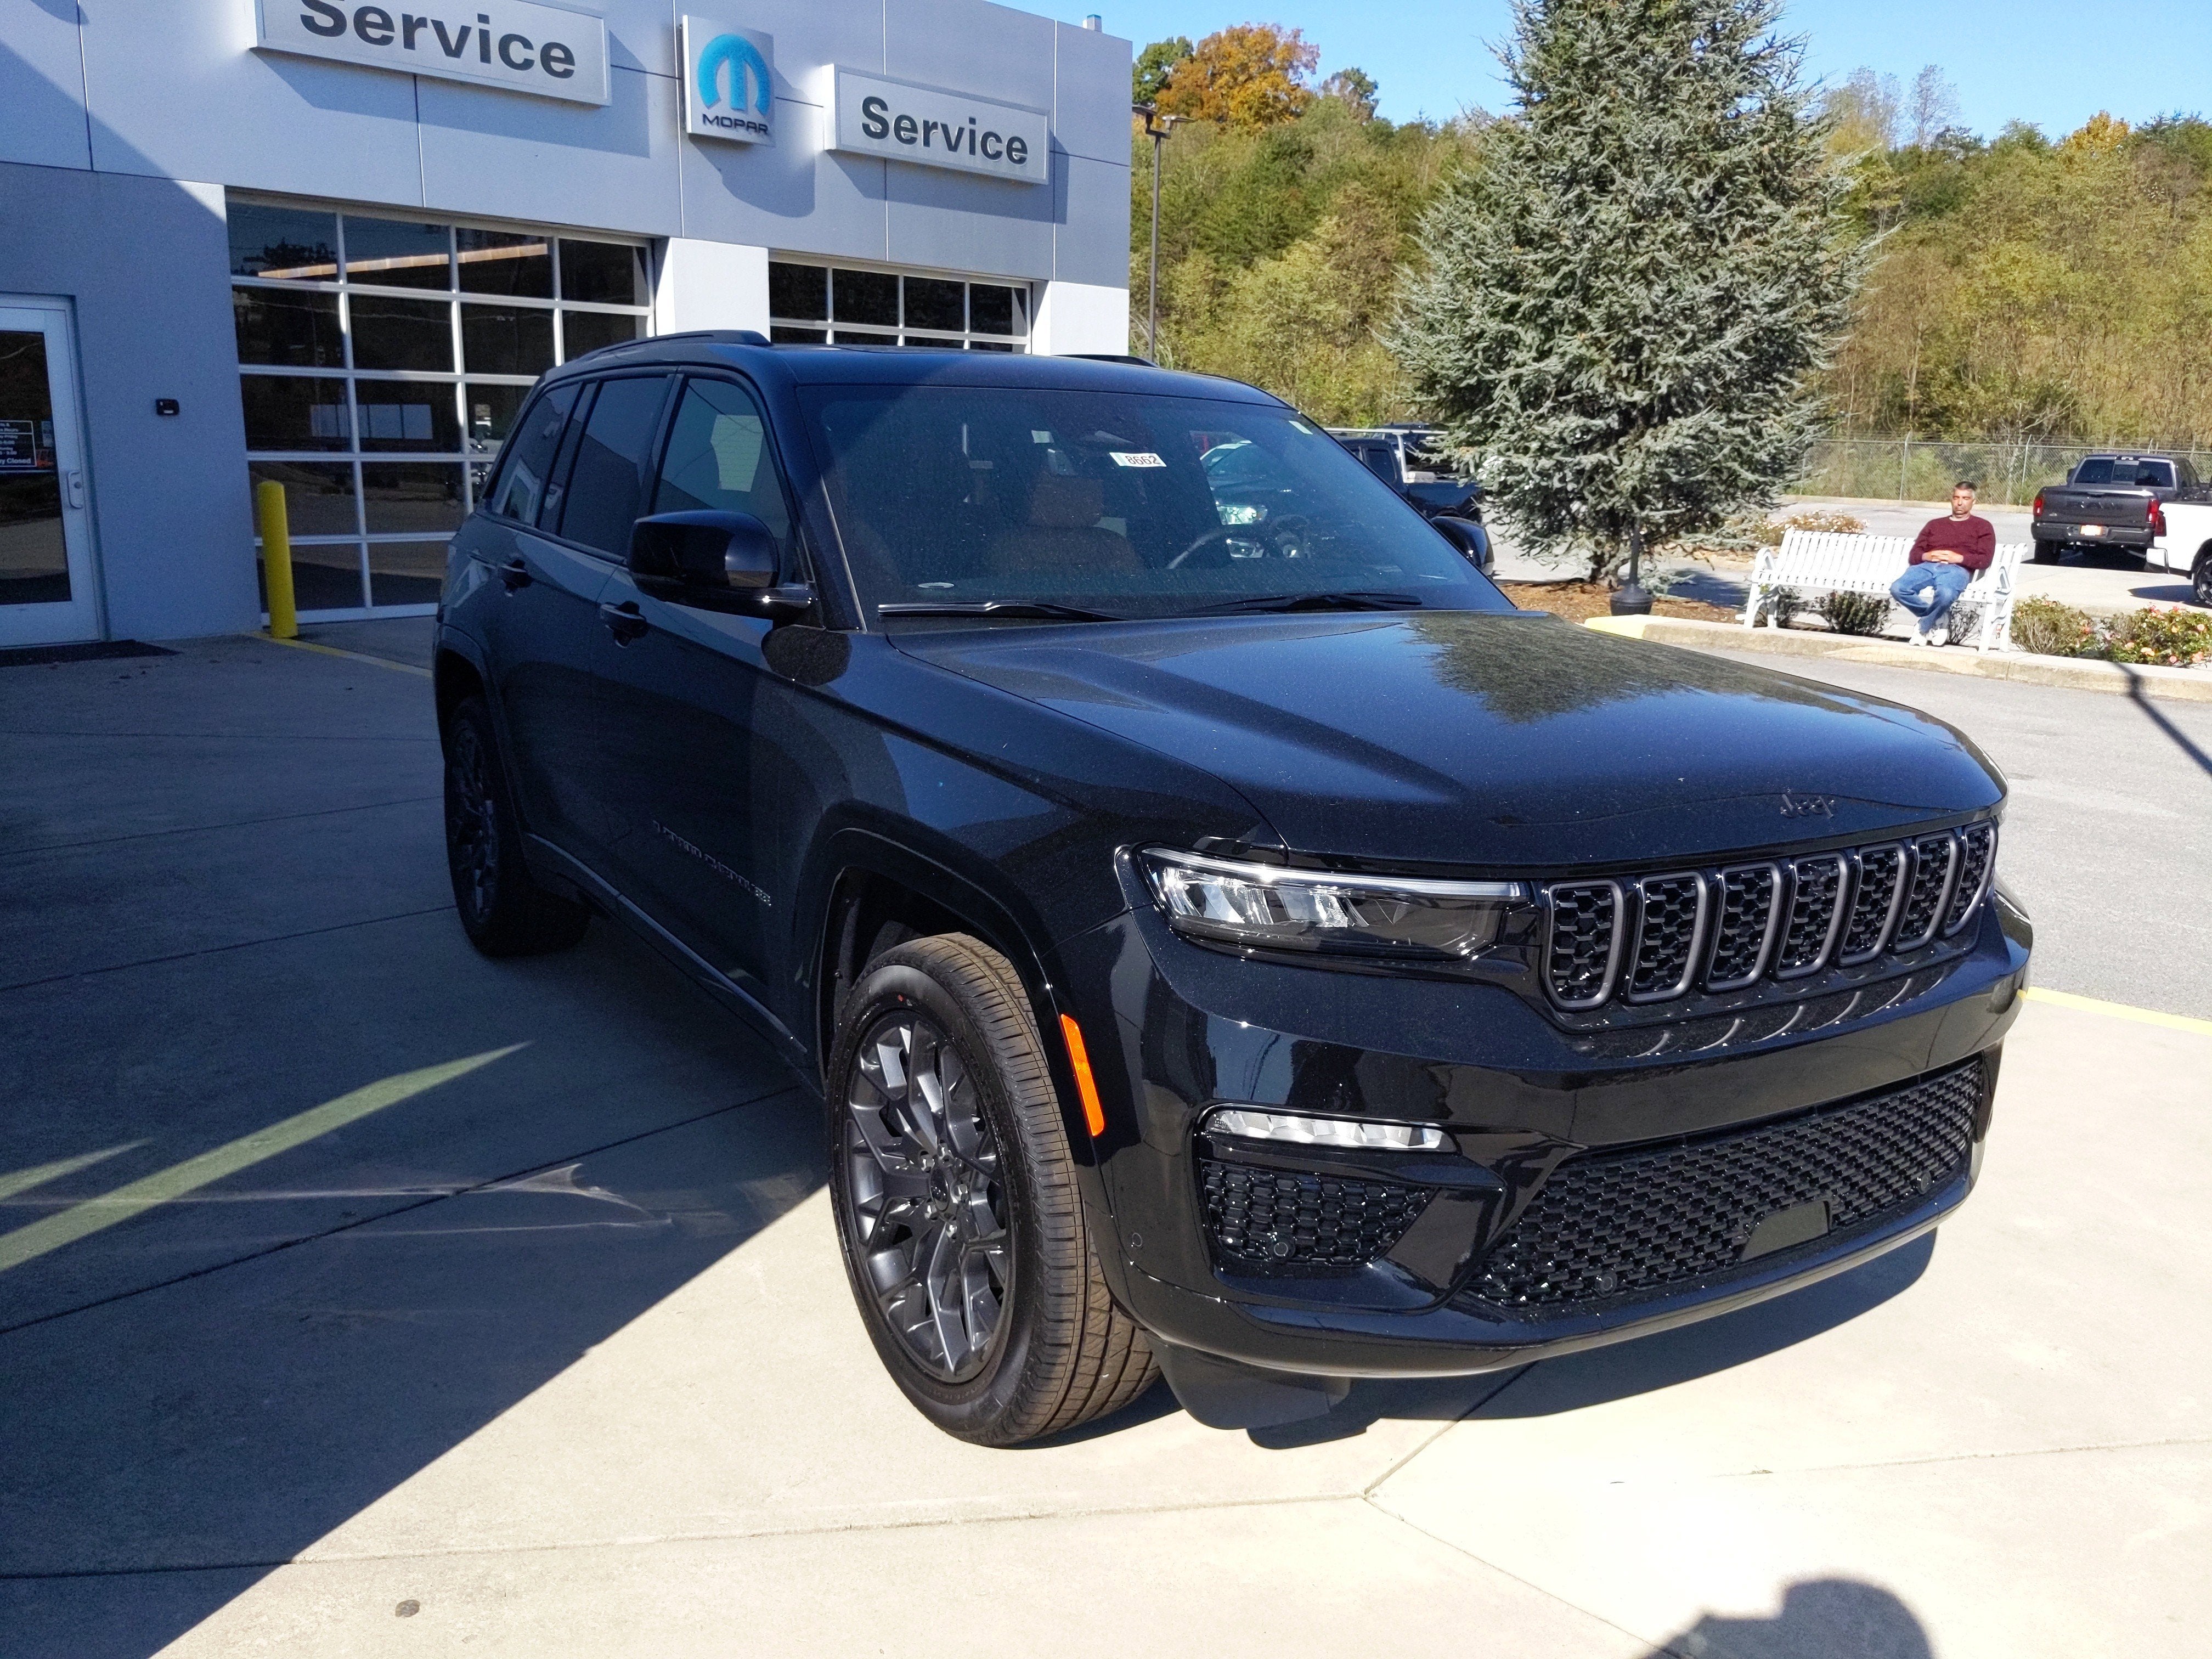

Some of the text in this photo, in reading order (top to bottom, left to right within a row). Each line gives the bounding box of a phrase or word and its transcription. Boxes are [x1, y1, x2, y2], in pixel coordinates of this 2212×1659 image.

[300, 0, 575, 79] Service
[702, 113, 769, 136] MOPAR
[861, 95, 1028, 165] Service
[1125, 455, 1161, 465] 8662
[1779, 793, 1835, 819] Jeep
